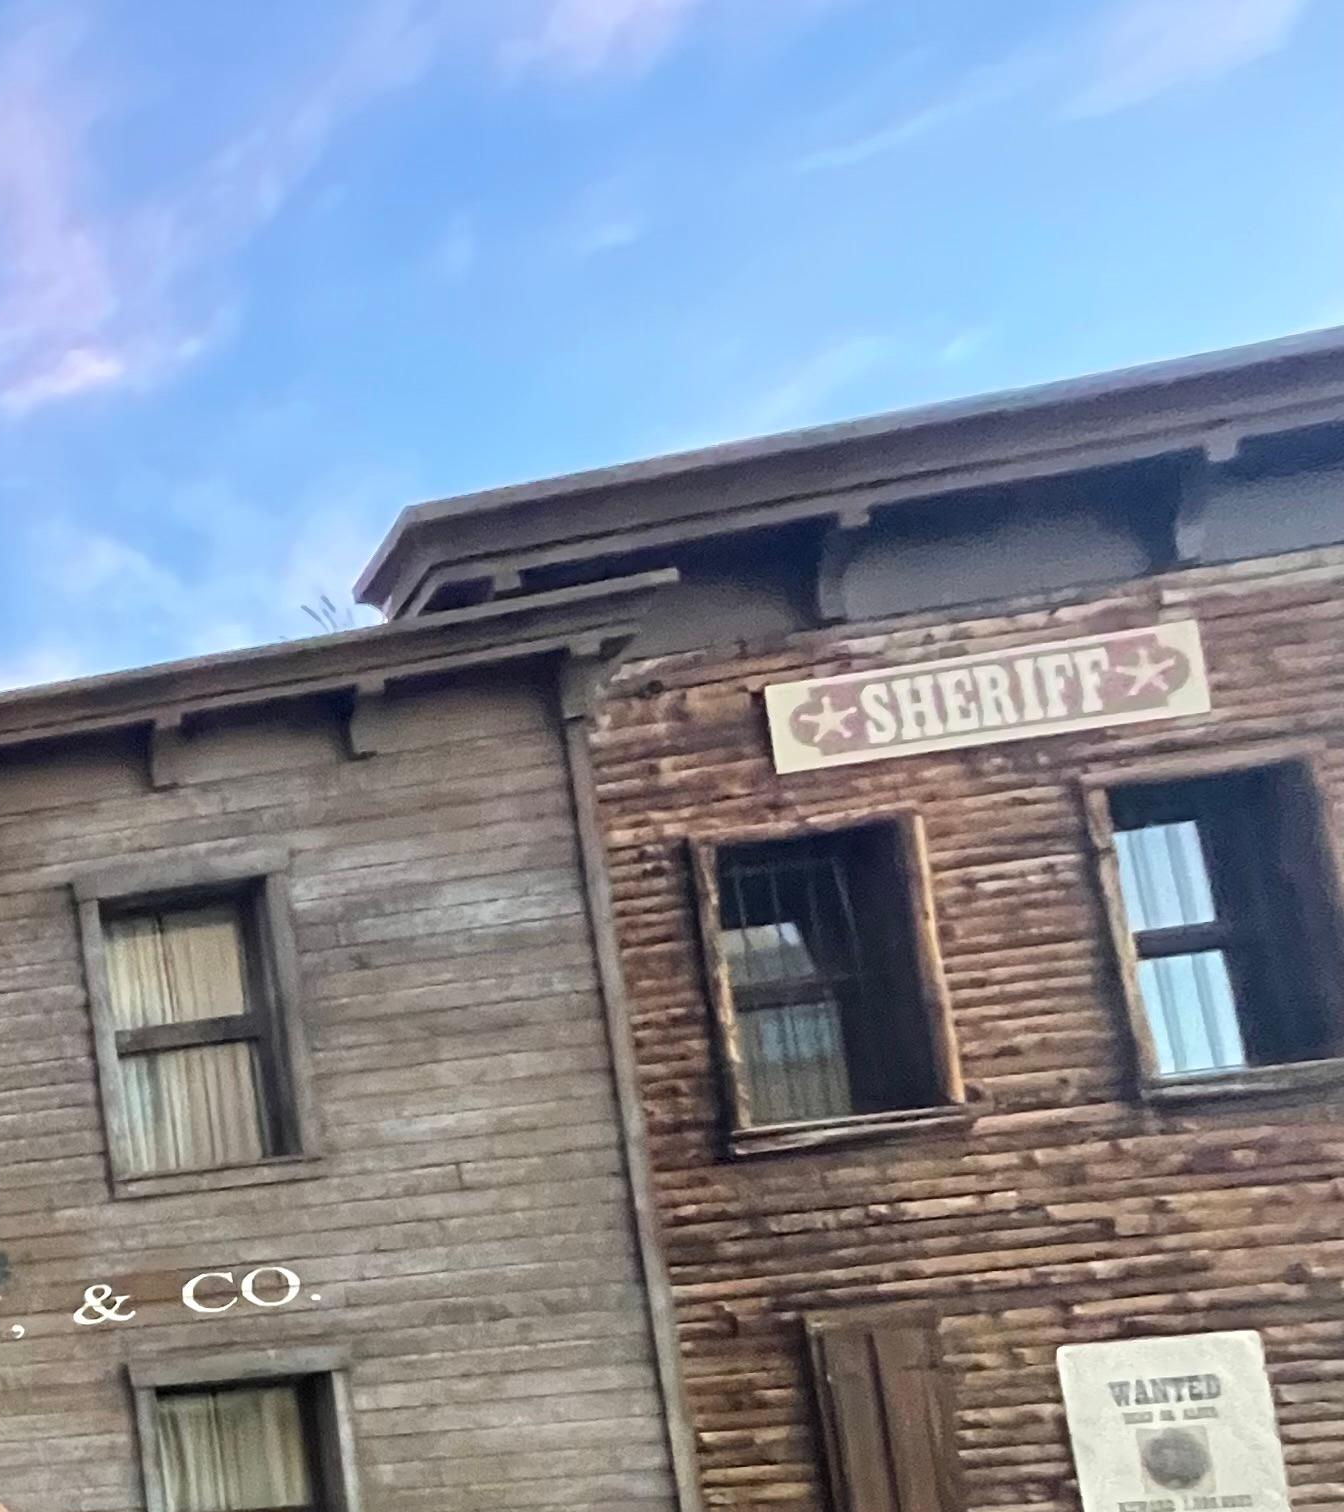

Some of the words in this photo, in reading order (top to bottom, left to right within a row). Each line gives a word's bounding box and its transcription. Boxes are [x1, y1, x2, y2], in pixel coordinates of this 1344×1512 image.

[861, 647, 1109, 744] SHERIFF
[72, 1284, 137, 1326] &
[181, 1266, 322, 1314] CO.
[1107, 1372, 1222, 1408] WANTED
